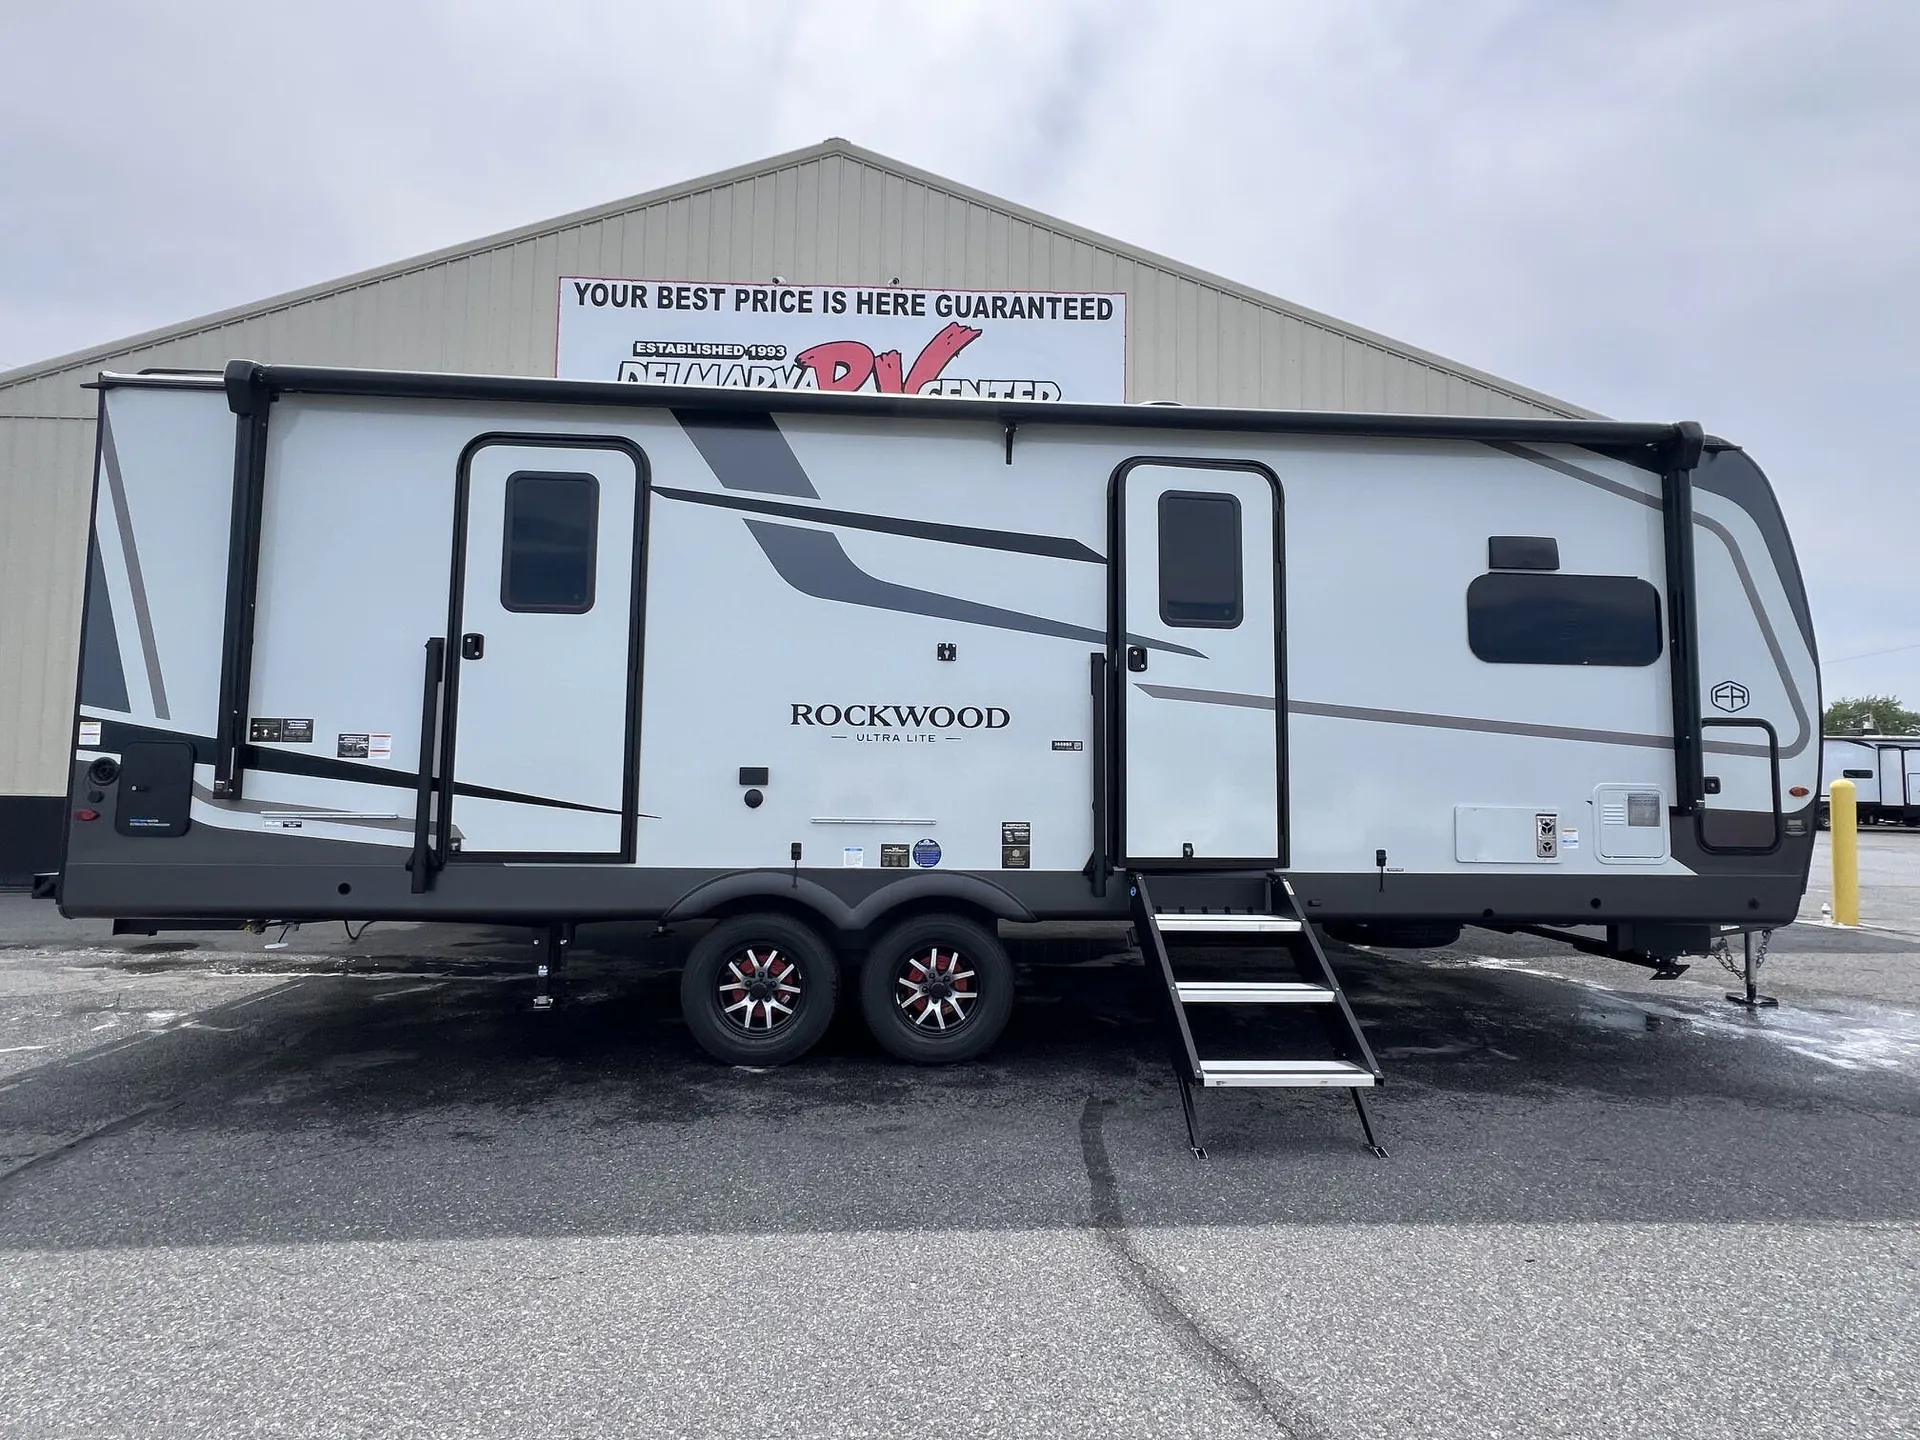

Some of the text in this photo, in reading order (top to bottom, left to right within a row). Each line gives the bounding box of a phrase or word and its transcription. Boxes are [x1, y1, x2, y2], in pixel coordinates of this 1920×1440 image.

[574, 282, 1114, 321] YOUR BEST PRICE IS HERE GUARANTEED
[634, 341, 787, 359] ESTABLISHED 1993
[790, 703, 1011, 729] ROCKWOOD
[856, 733, 936, 743] ULTRA LITE
